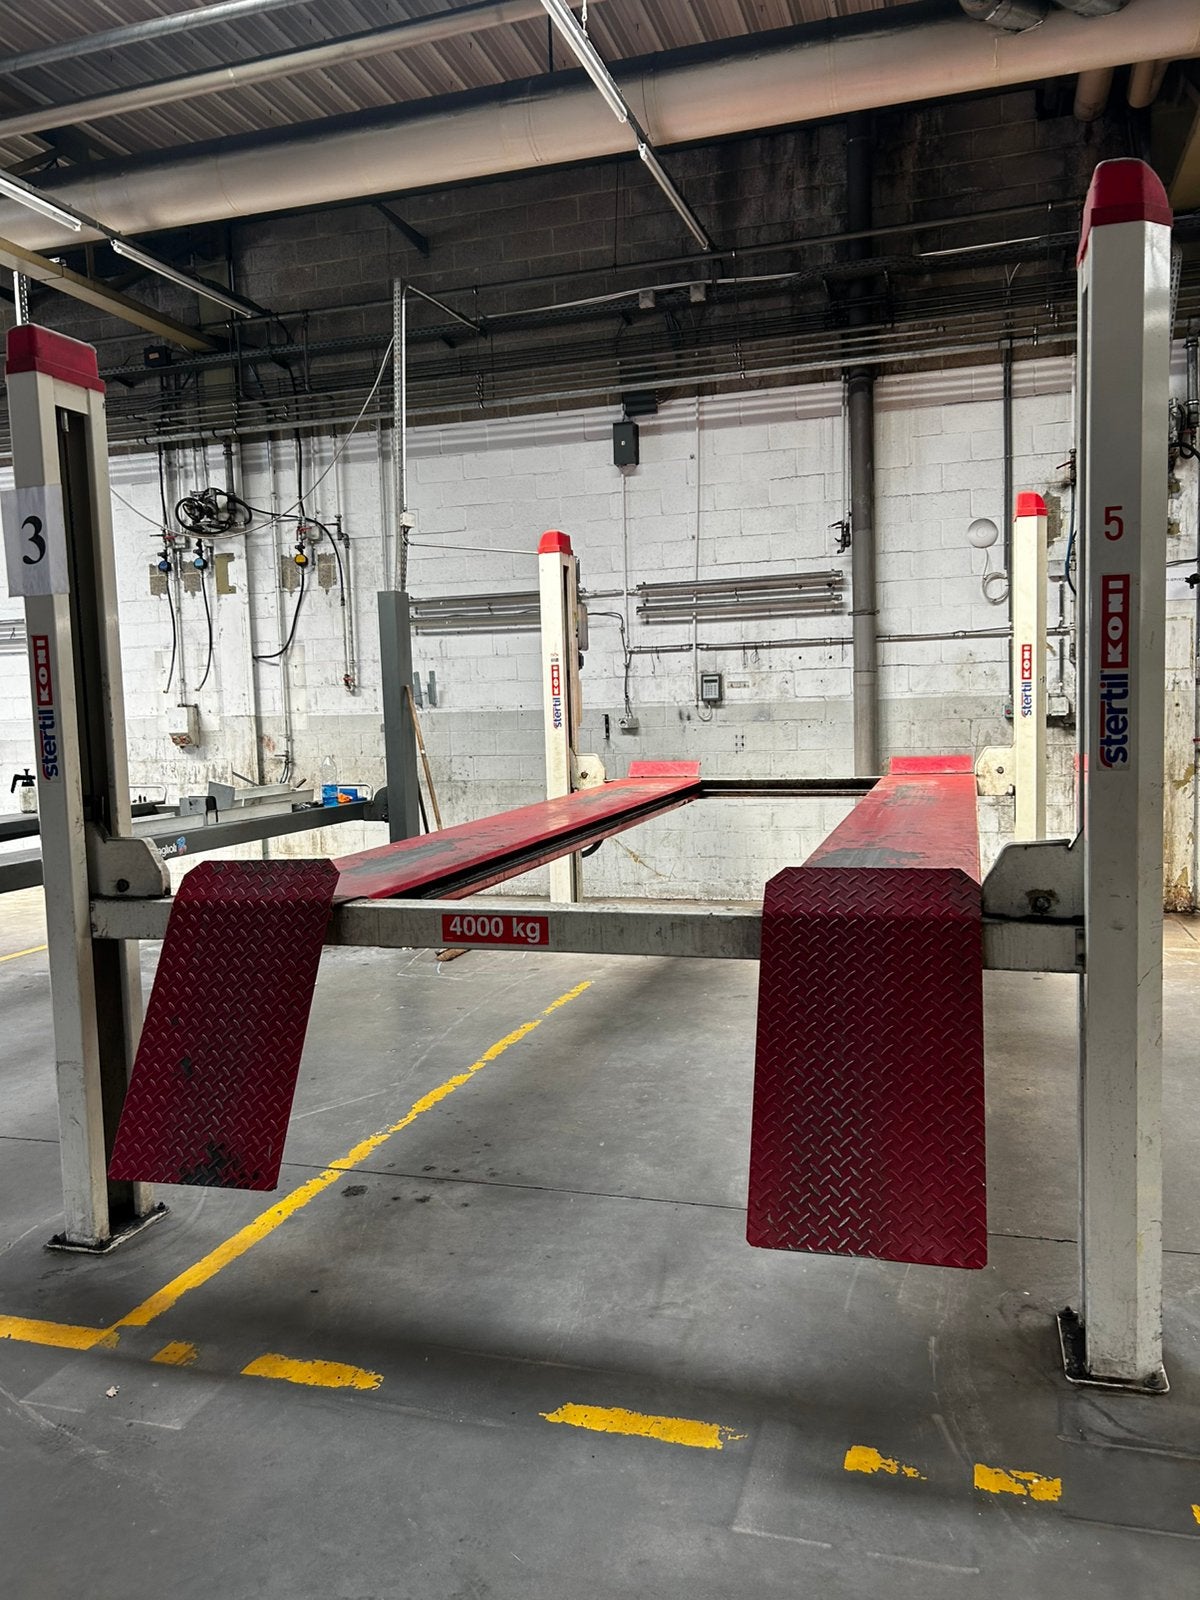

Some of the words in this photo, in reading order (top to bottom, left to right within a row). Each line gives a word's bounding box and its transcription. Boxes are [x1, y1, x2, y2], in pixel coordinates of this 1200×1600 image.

[21, 515, 47, 566] 3
[1104, 505, 1124, 541] 5
[1106, 578, 1126, 665] KONI
[35, 638, 51, 703] KONI
[1023, 645, 1031, 679] KONI
[552, 697, 562, 729] stertil
[1021, 681, 1032, 717] stertil
[1100, 673, 1129, 766] stertil
[38, 709, 58, 779] stertil
[449, 916, 504, 938] 4000
[512, 917, 540, 944] kg
